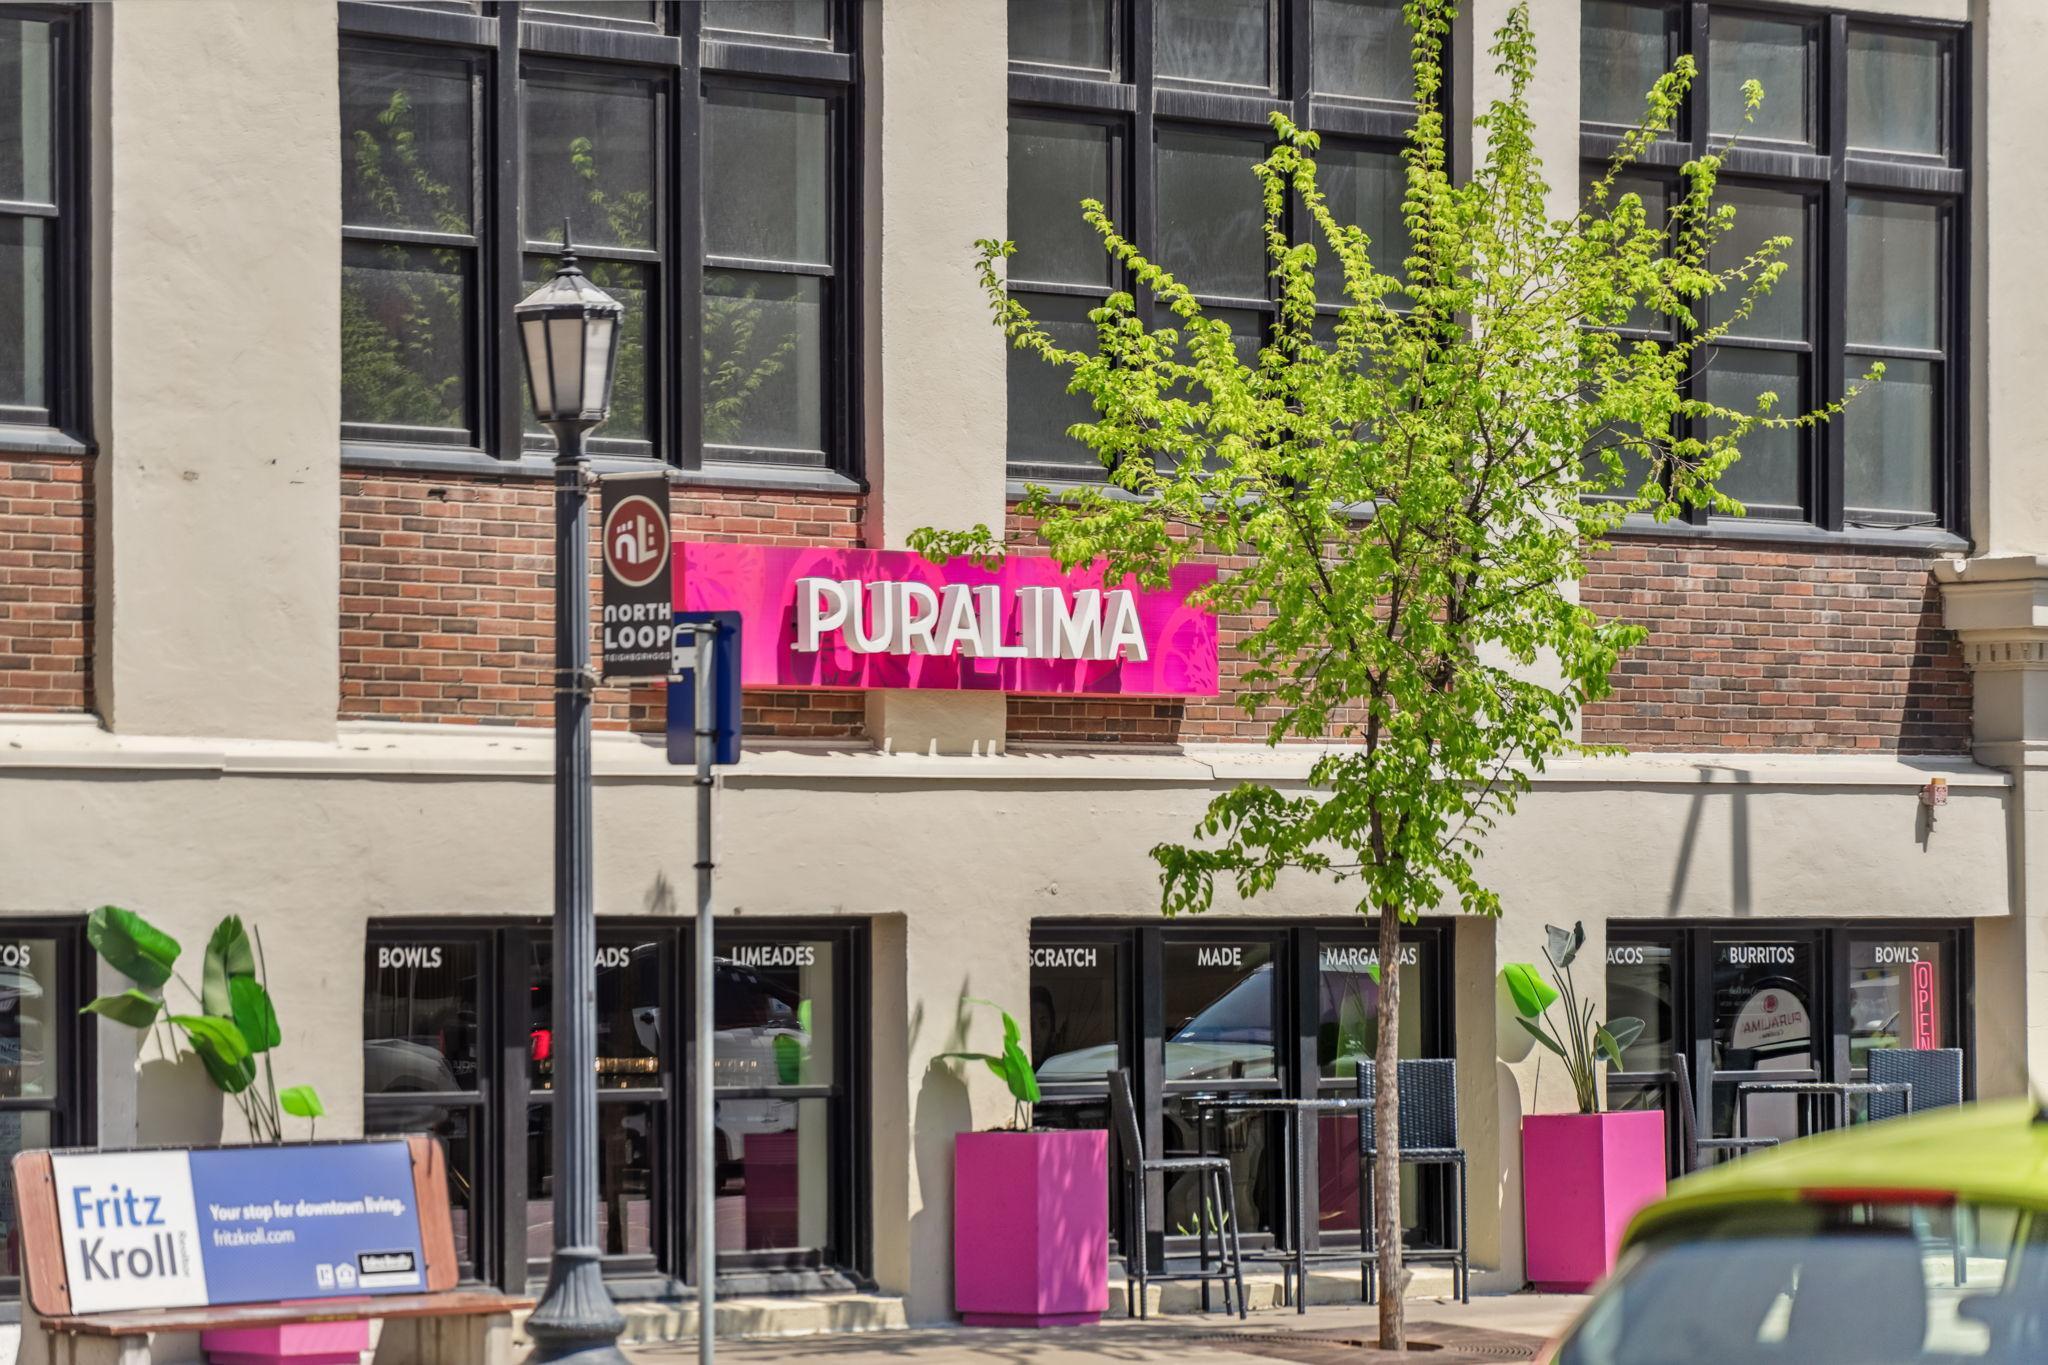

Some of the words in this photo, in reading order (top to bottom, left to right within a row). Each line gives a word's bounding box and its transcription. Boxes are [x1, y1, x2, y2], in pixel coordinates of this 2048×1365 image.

[604, 602, 671, 623] NORTH
[791, 577, 1148, 661] PURALIMA
[604, 625, 671, 650] LOOP
[0, 944, 30, 967] OS
[378, 947, 442, 968] BOWLS
[594, 947, 630, 968] ADS
[732, 946, 815, 967] LIMEADES
[1197, 947, 1242, 967] MADE
[1326, 947, 1417, 966] MARGAAS
[1606, 946, 1644, 965] ACOS
[1729, 946, 1795, 964] BURRITOS
[1875, 946, 1919, 963] BOWLS
[1918, 966, 1931, 1050] OPEN
[72, 1183, 165, 1230] Fritz
[209, 1204, 241, 1222] Your
[243, 1204, 273, 1223] stop
[274, 1200, 294, 1219] for
[296, 1198, 364, 1217] downtown
[364, 1195, 406, 1217] living.
[213, 1226, 296, 1248] fritzkroll.com
[80, 1232, 178, 1281] Kroll
